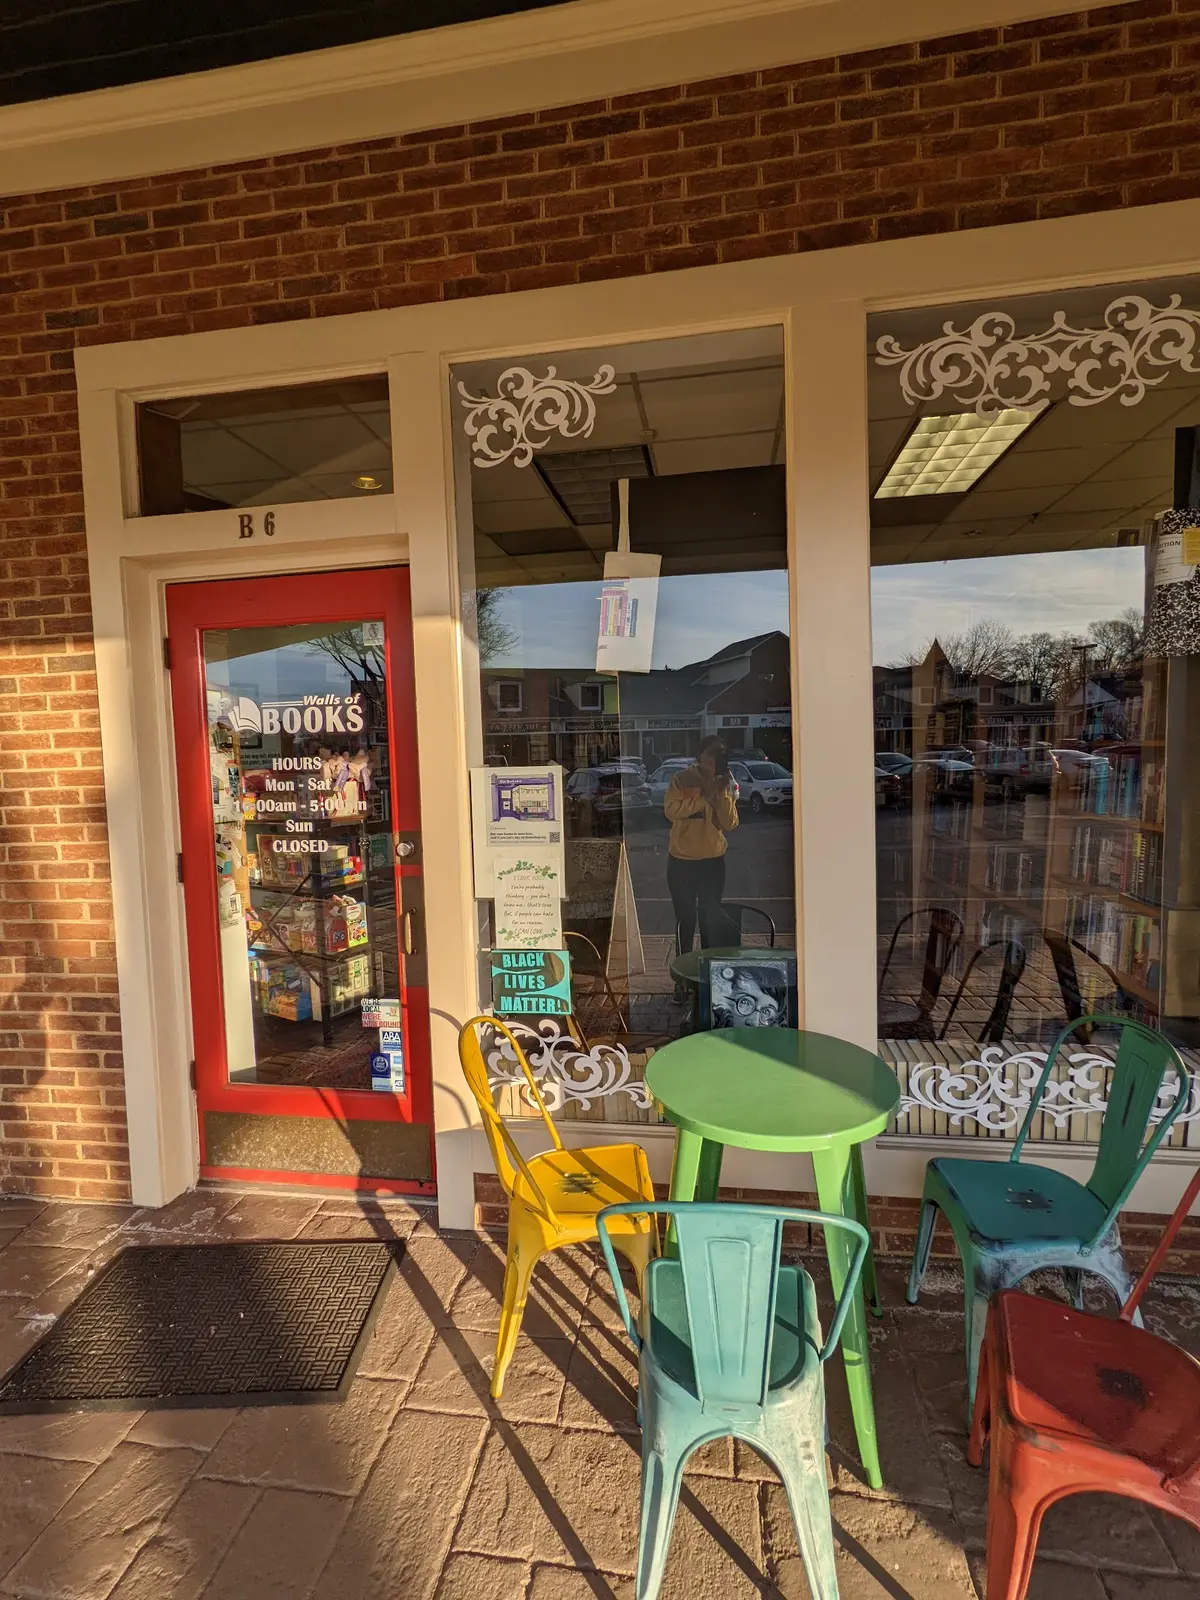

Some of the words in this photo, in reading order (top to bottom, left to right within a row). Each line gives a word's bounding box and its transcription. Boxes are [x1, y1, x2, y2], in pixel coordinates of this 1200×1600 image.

[238, 513, 253, 539] B
[264, 512, 276, 536] 6
[302, 694, 341, 706] Walls
[345, 693, 361, 705] of
[263, 705, 364, 735] BOOKS
[272, 757, 322, 771] HOURS
[265, 778, 295, 792] Mon
[307, 778, 333, 791] Sat
[285, 820, 313, 832] Sun
[272, 839, 329, 853] CLOSED
[502, 952, 545, 968] BLACK
[504, 974, 546, 989] LIVES
[500, 996, 561, 1012] MATTER!
